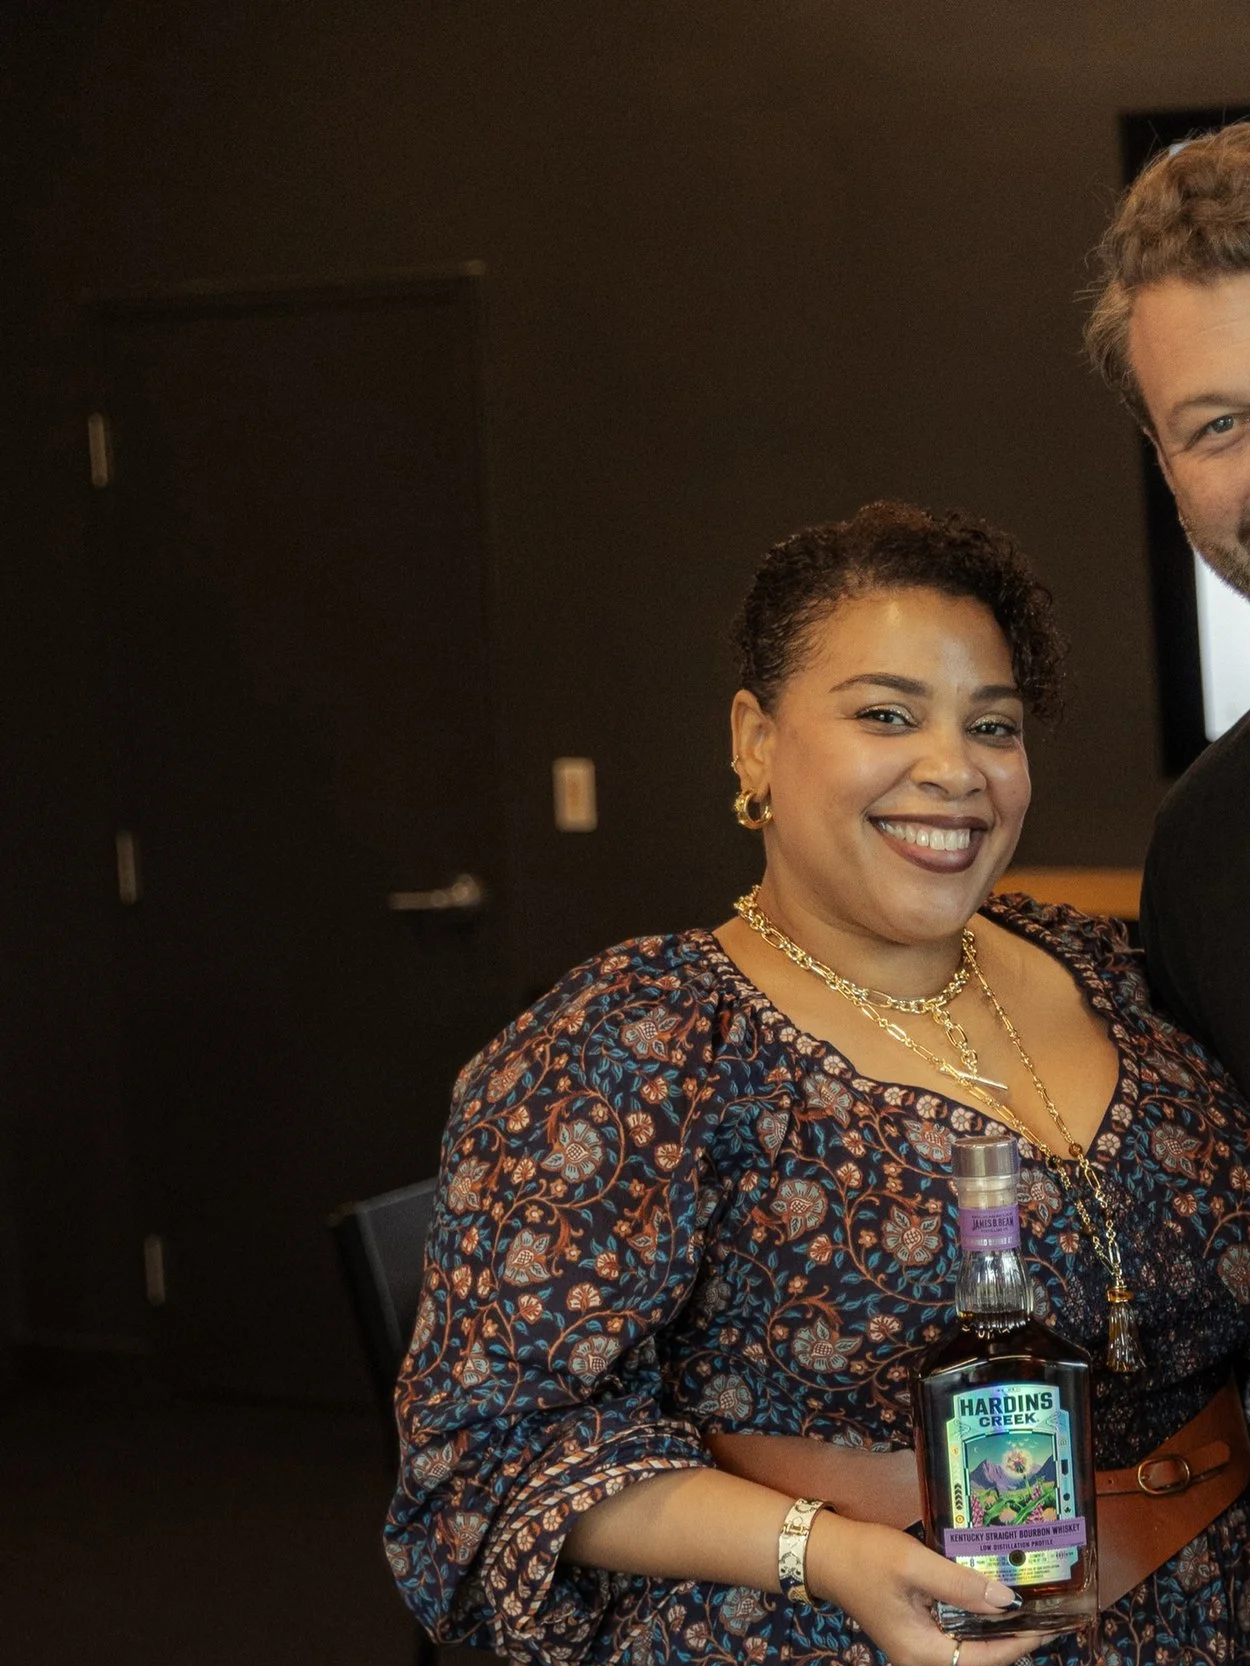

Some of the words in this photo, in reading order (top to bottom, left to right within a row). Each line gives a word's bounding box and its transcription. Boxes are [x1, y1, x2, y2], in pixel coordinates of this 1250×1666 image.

[979, 1412, 1037, 1428] CREEK
[950, 1532, 984, 1543] KENTUCKY
[985, 1530, 1018, 1541] STRAIGHT
[1019, 1526, 1051, 1539] BOURBON
[1051, 1523, 1081, 1536] WHISKEY
[980, 1544, 991, 1552] LOW
[993, 1541, 1031, 1552] DISTILLATION
